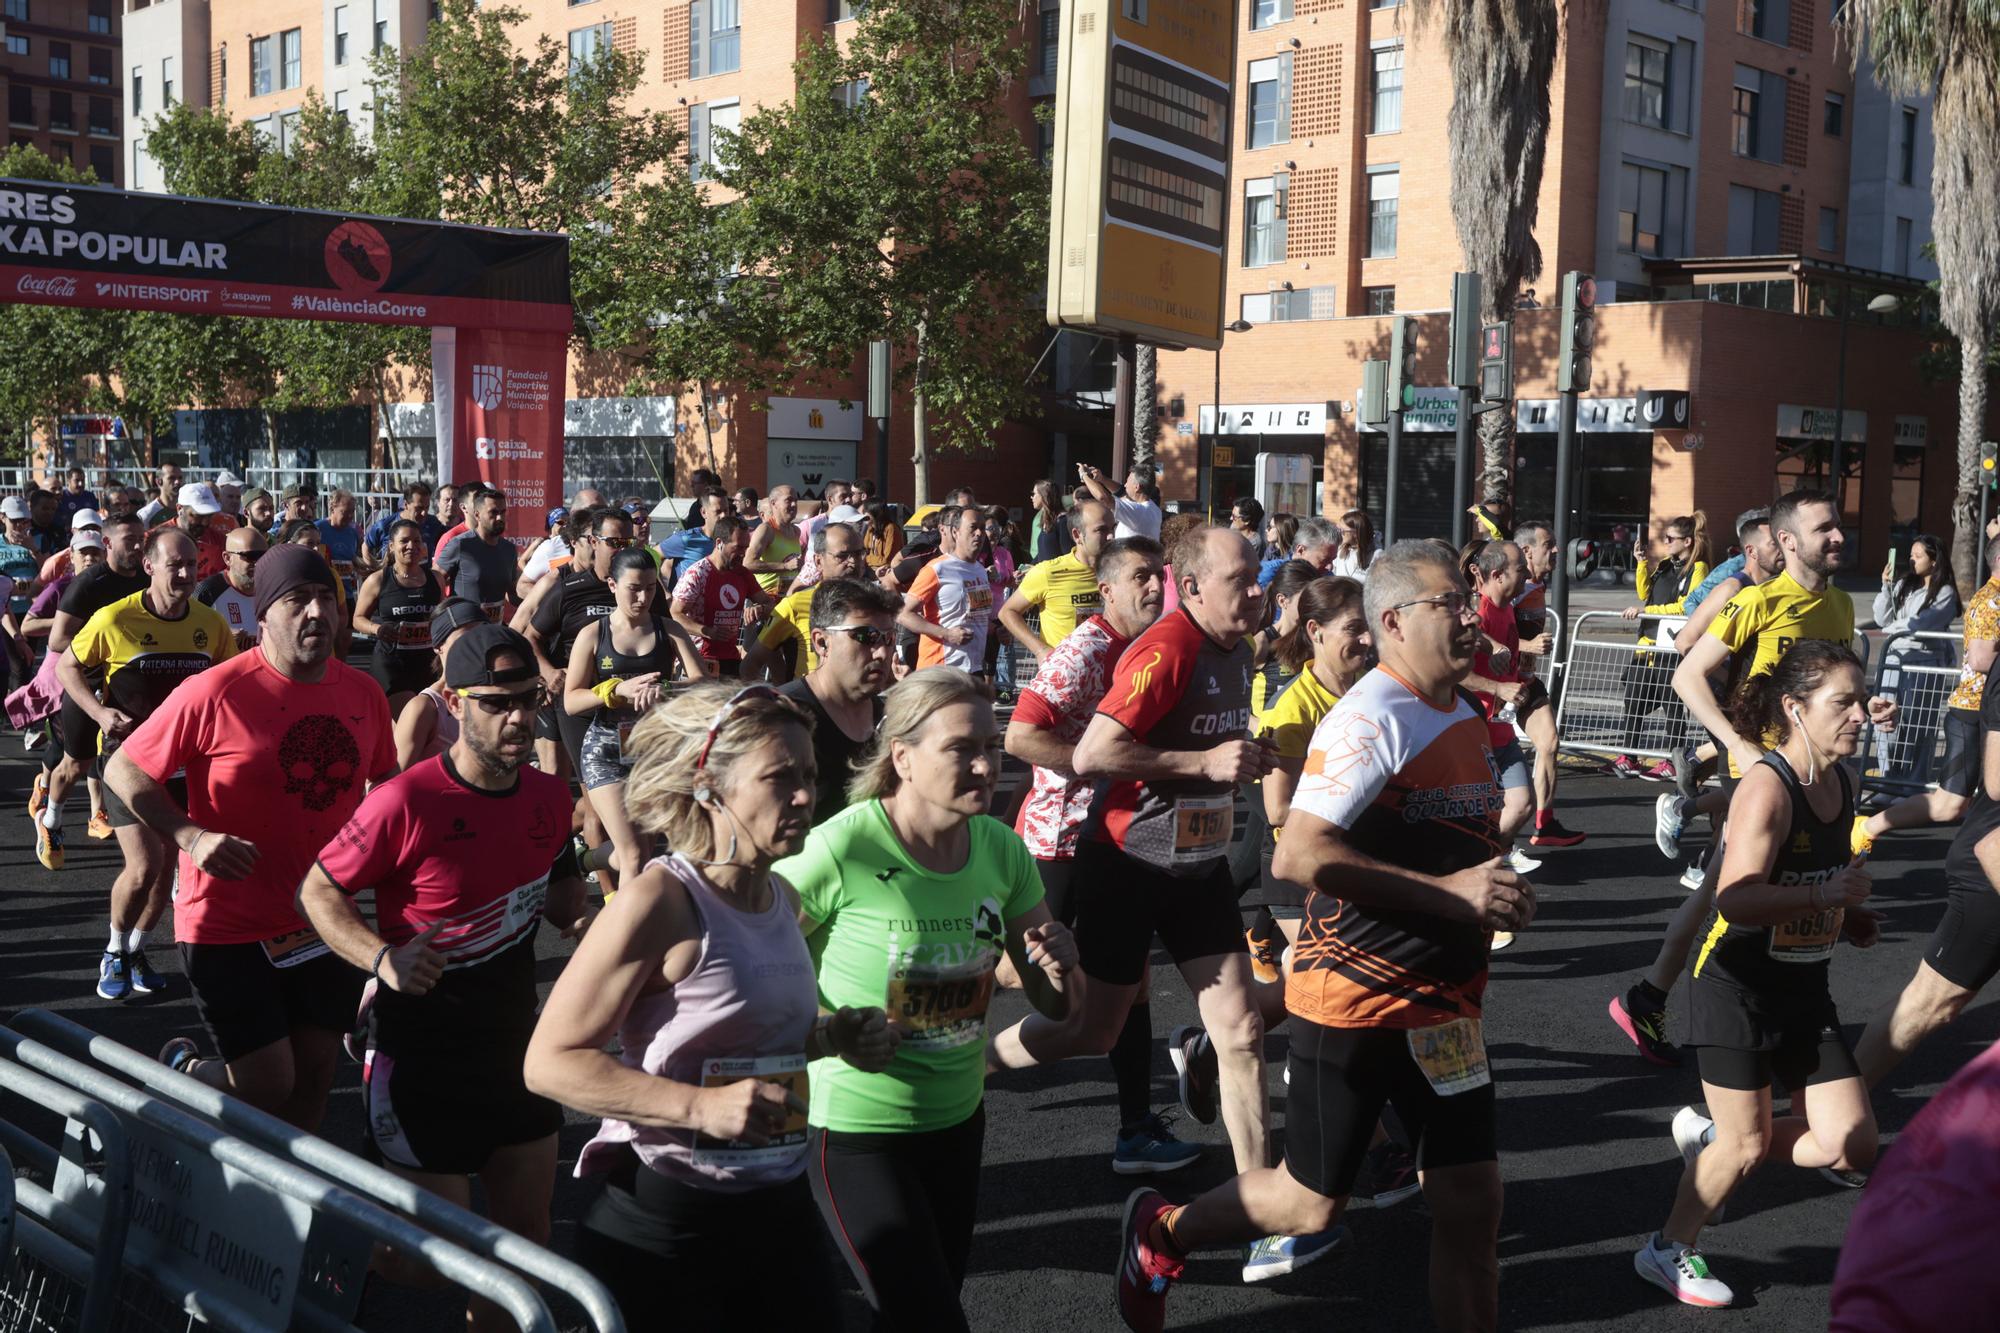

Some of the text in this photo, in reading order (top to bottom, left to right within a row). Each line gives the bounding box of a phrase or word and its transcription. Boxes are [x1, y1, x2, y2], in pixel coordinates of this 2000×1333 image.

[53, 229, 228, 269] POPULAR
[112, 284, 209, 303] INTERSPORT
[232, 293, 271, 302] aspaym
[291, 295, 426, 317] #ValènciaCorre
[506, 369, 548, 380] Fundació
[506, 380, 549, 391] Esportiva
[506, 390, 549, 400] Municipal
[506, 399, 543, 410] València
[1412, 396, 1457, 410] Urban
[1404, 410, 1456, 427] unning
[498, 440, 527, 449] caixa
[498, 450, 544, 460] popular
[504, 488, 544, 498] TRINIDAD
[1071, 592, 1100, 604] REDO
[392, 604, 436, 616] REDOLA
[140, 660, 208, 669] PATERNA RUNNERS
[1190, 714, 1217, 735] CD
[1406, 783, 1494, 803] CLUB ATLETISME
[1402, 799, 1466, 823] QUART
[1466, 798, 1485, 816] DE
[888, 917, 974, 932] runners
[127, 1136, 194, 1199] ALENCIA
[168, 1207, 201, 1260] DEL
[205, 1228, 285, 1305] RUNNING
